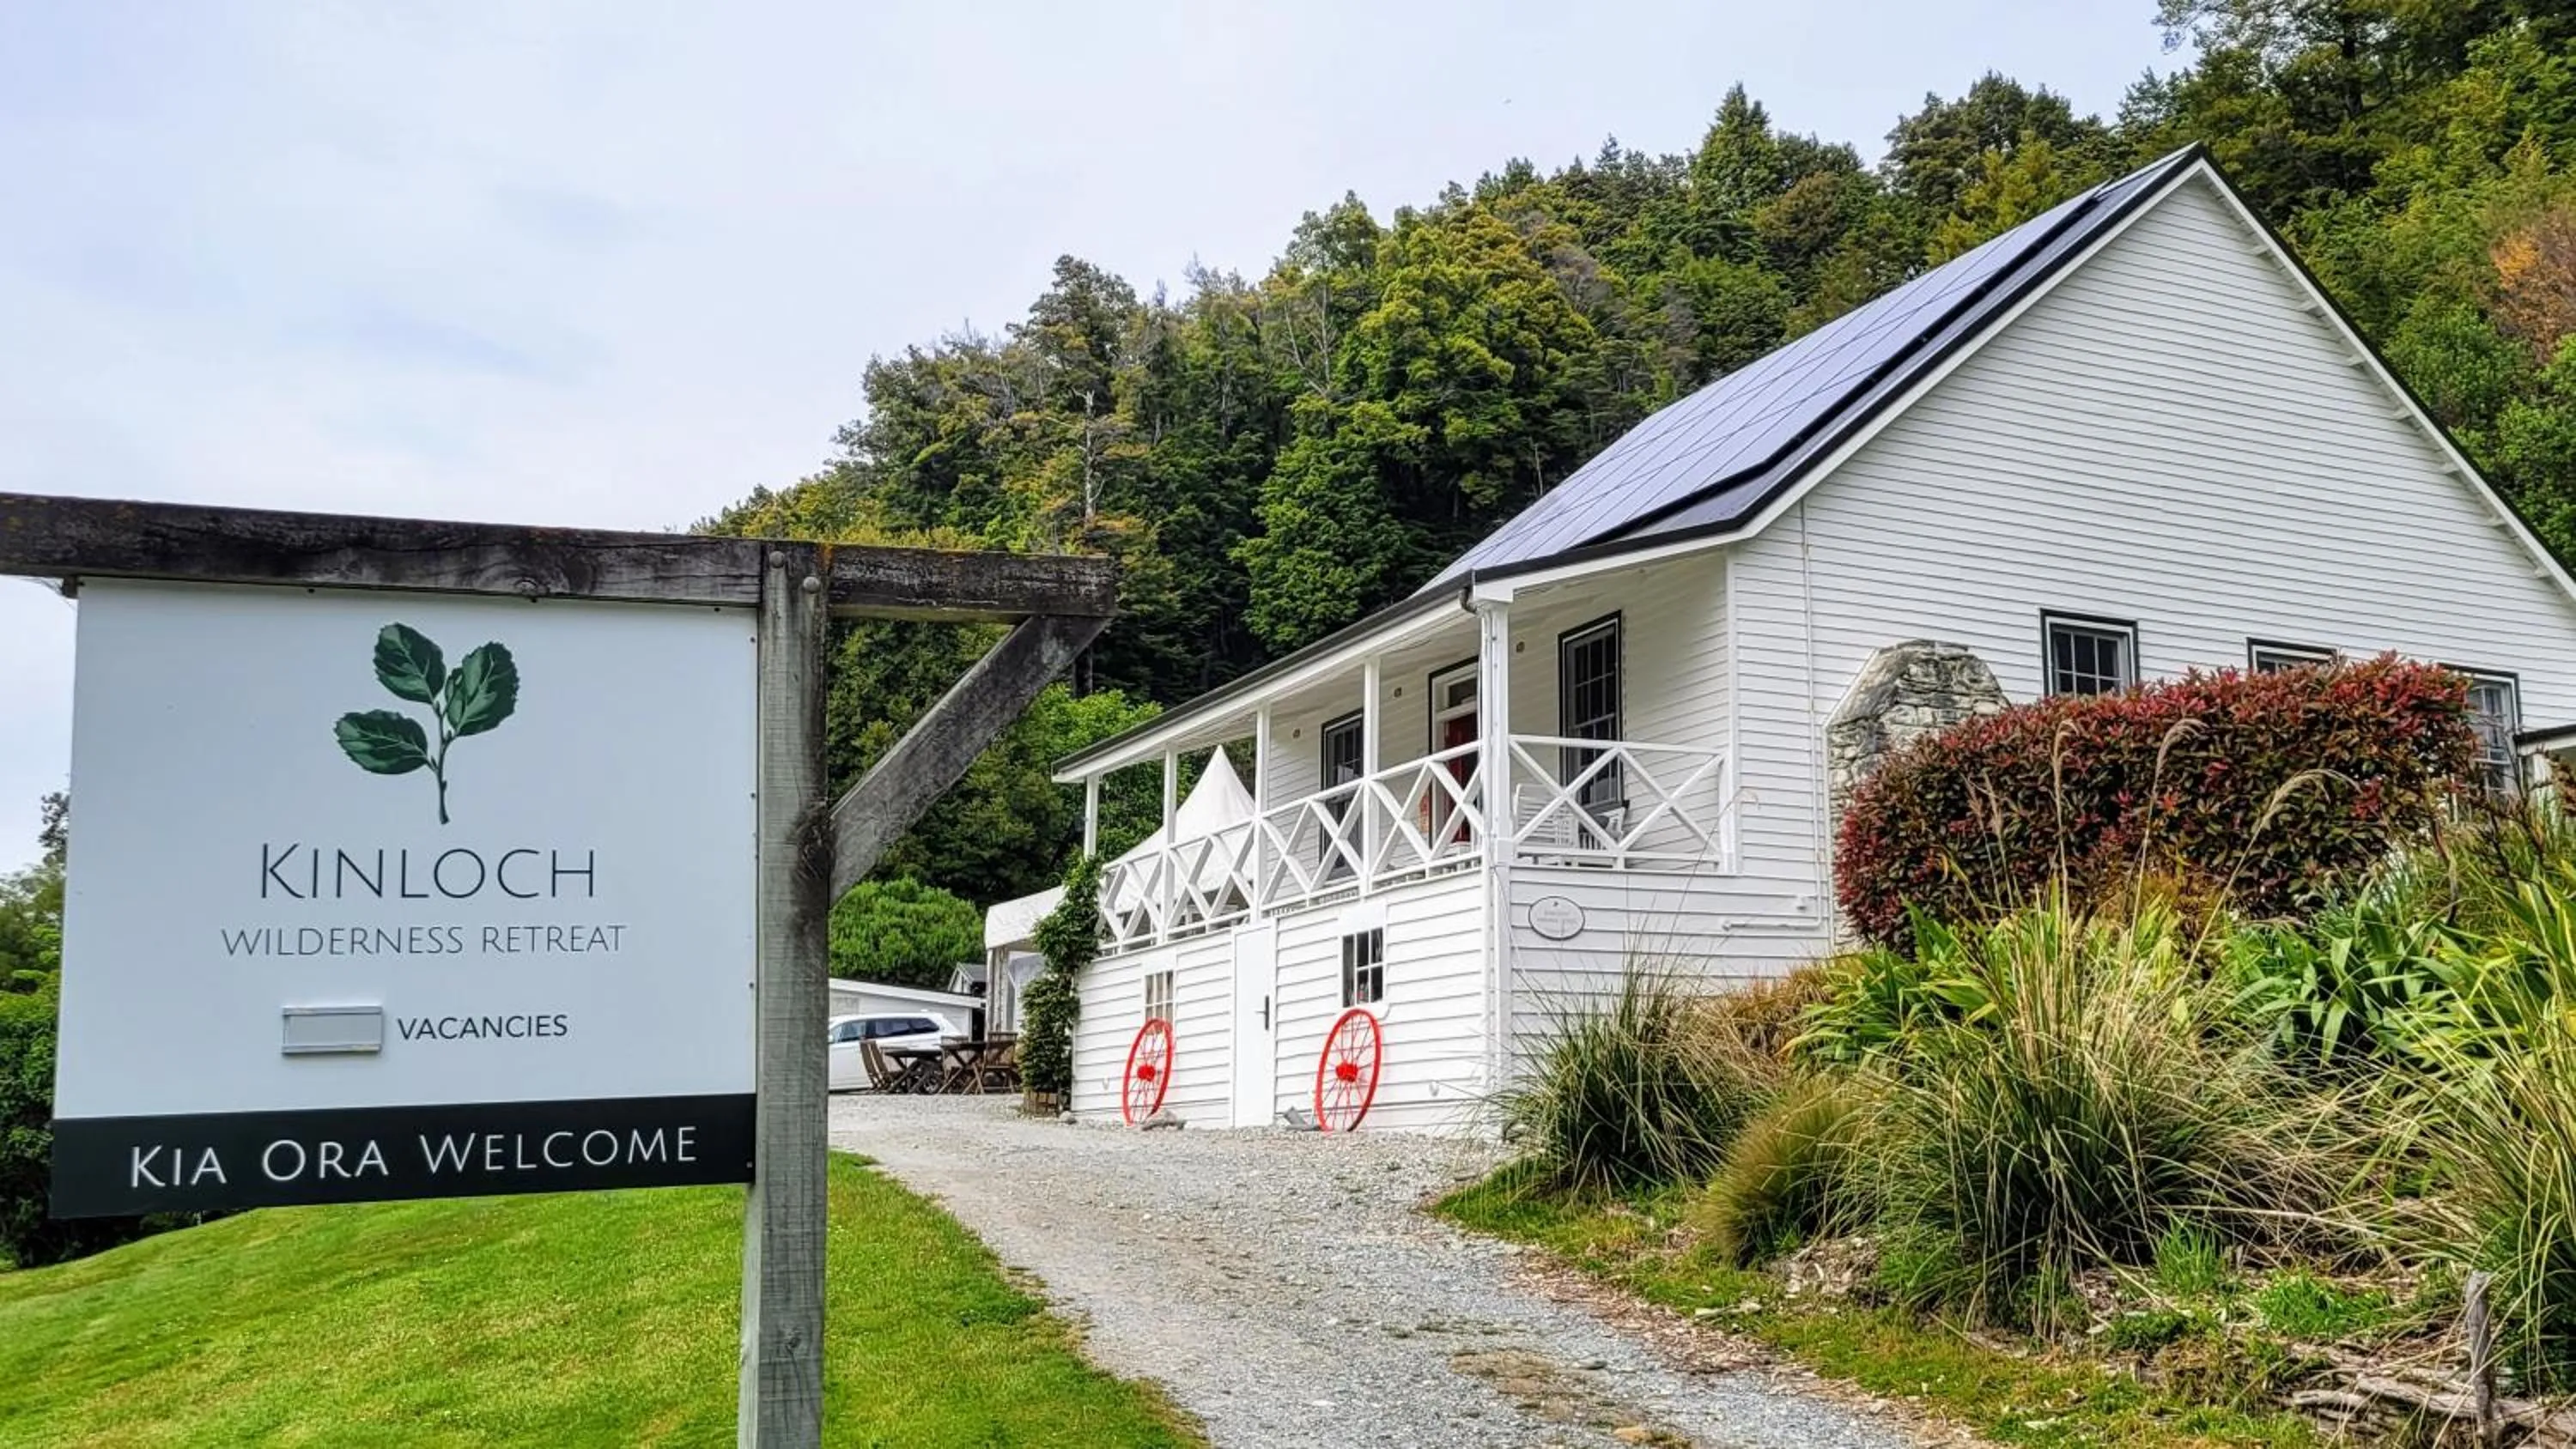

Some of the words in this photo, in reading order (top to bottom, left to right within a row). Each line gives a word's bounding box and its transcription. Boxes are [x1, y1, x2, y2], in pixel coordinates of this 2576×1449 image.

[261, 843, 594, 899] KINLOCH
[221, 927, 464, 956] WILDERNESS
[483, 925, 627, 954] RETREAT
[397, 1014, 568, 1041] VACANCIES
[131, 1144, 228, 1189] KIA
[261, 1139, 390, 1183] ORA
[419, 1125, 698, 1175] WELCOME
